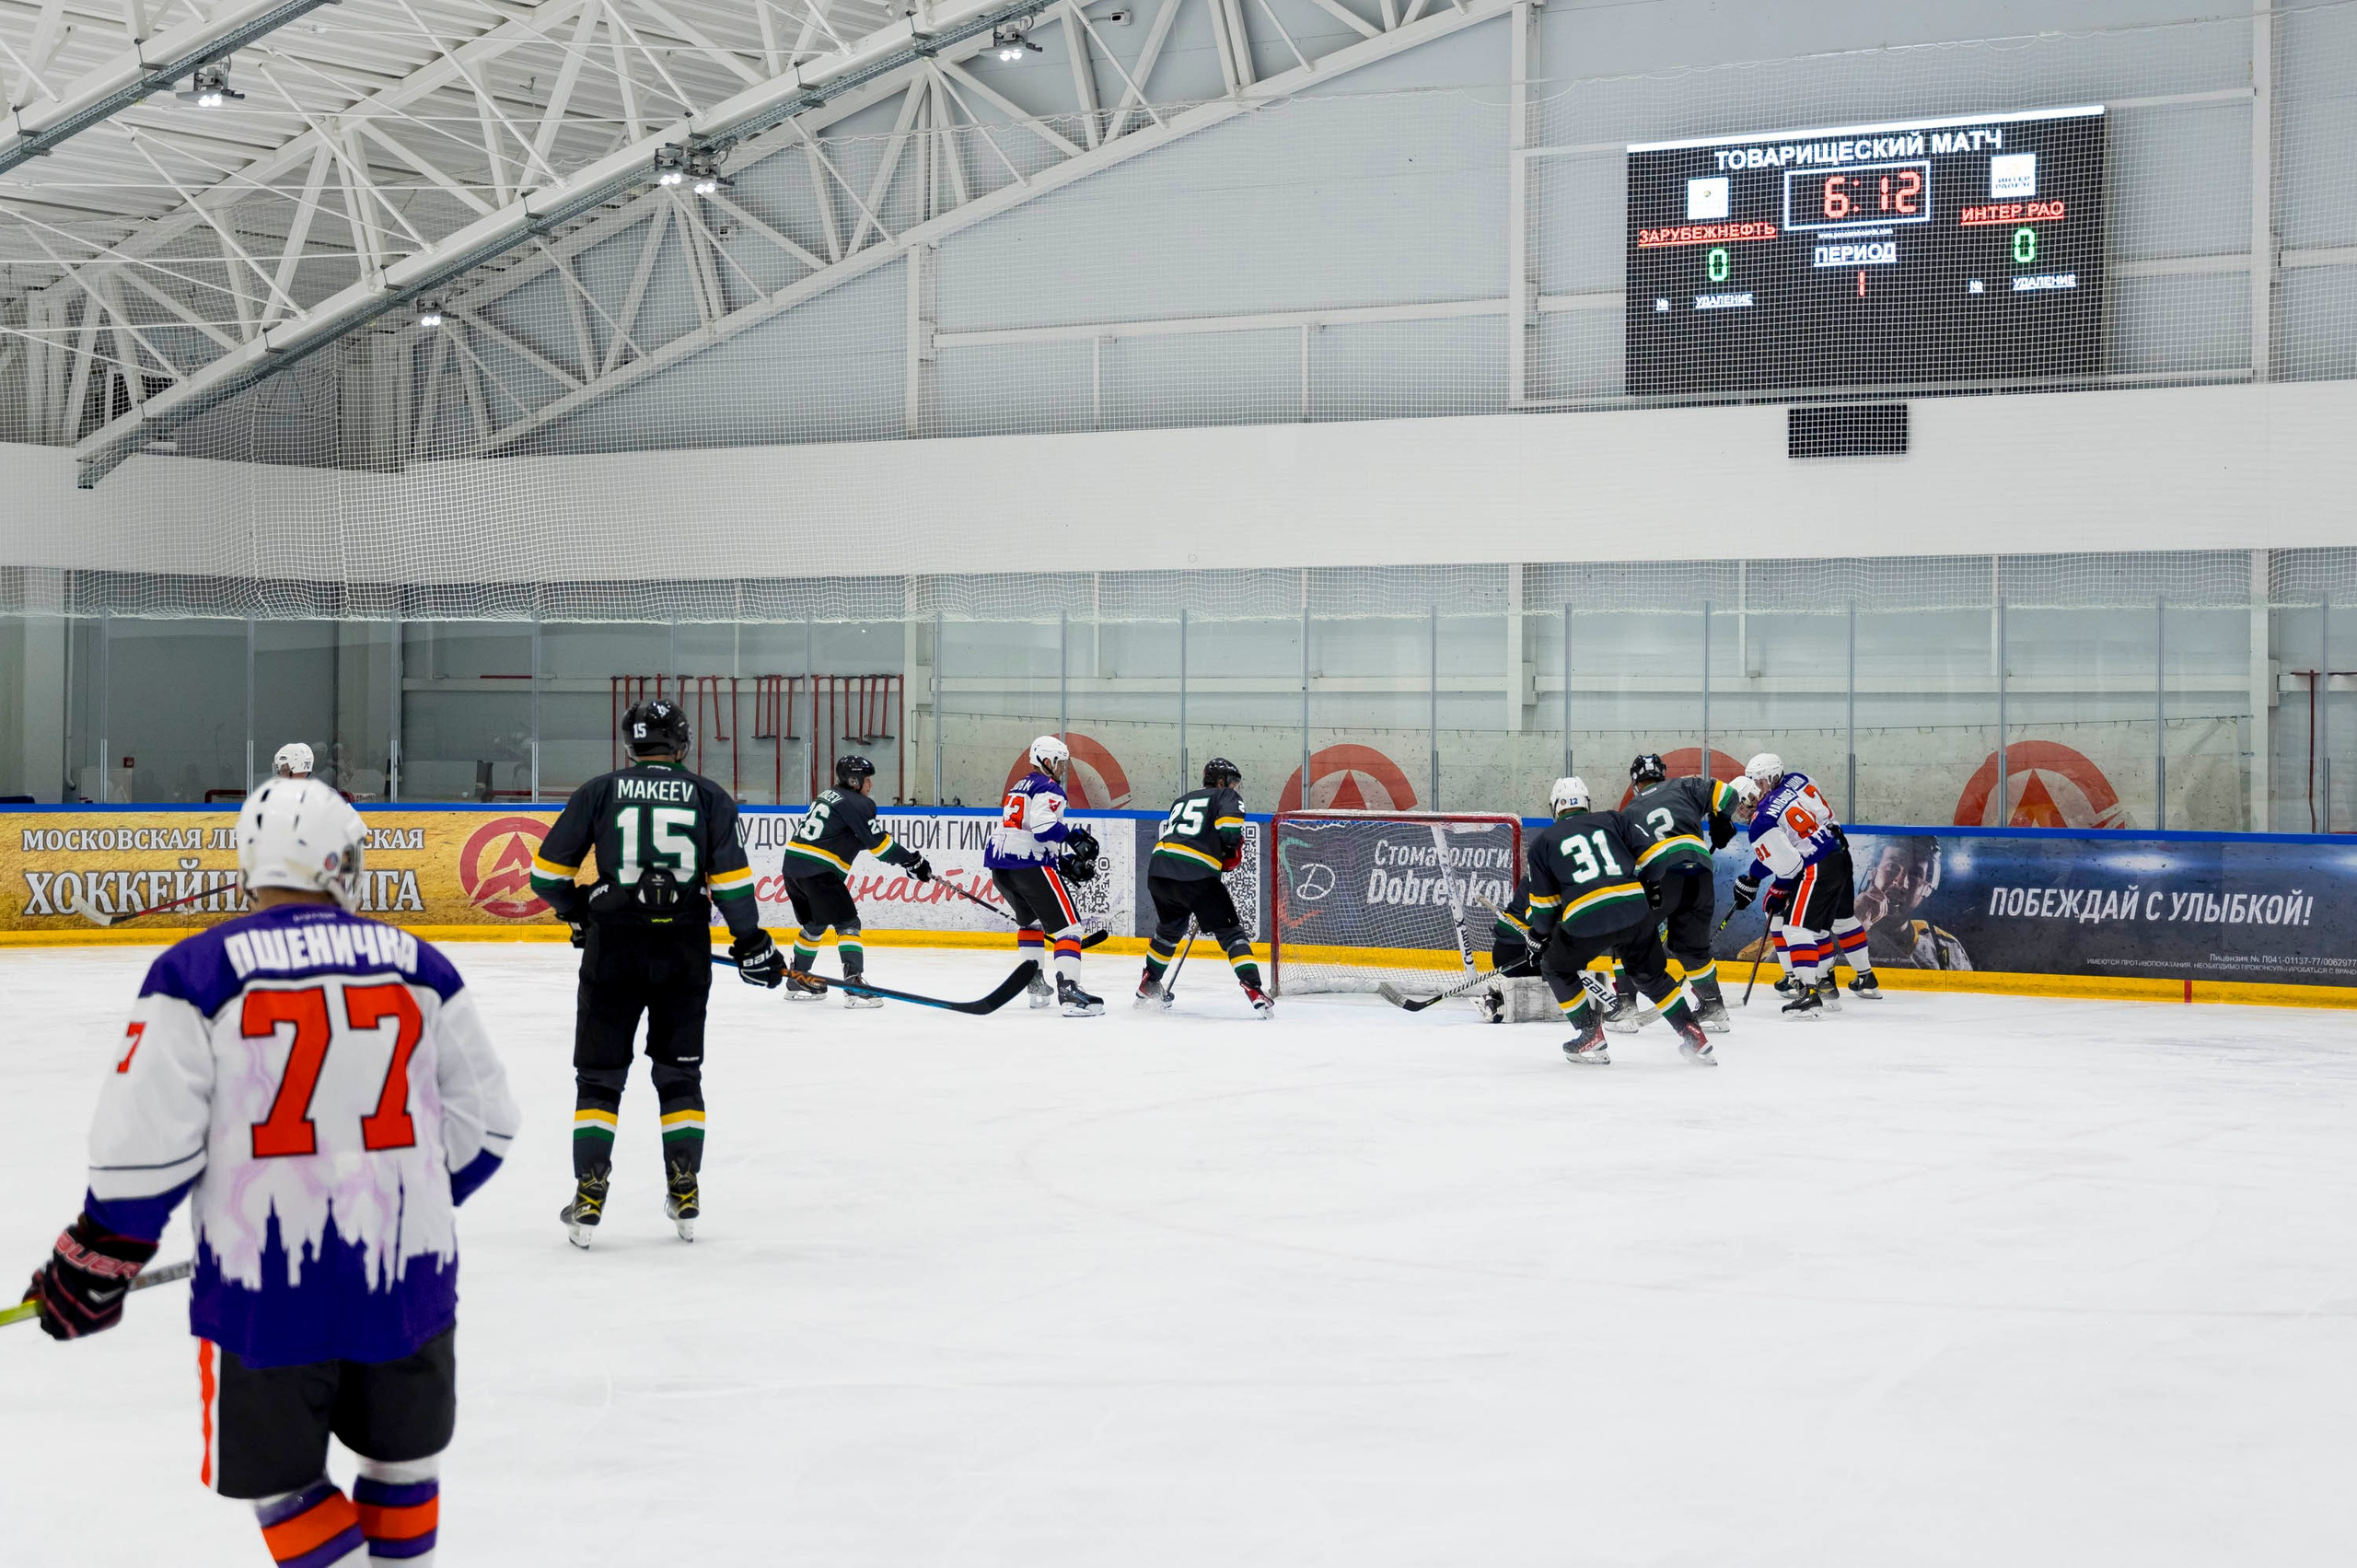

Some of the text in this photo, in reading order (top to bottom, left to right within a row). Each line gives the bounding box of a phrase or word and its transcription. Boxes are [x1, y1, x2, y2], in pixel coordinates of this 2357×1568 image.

[1714, 130, 2003, 170] ТОВАРИЩЕСКИЙ МАТЧ
[1824, 171, 1921, 217] 6:12
[1961, 201, 2064, 223] ИНТЕР РАО
[1639, 222, 1776, 245] ЗАРУБЕЖНЕФТЬ
[2014, 228, 2036, 263] 0
[1709, 248, 1728, 281] 0
[1814, 242, 1897, 264] ПЕРИОД
[2013, 274, 2076, 289] УДАЛЕНИЕ
[1695, 294, 1753, 308] УДАЛЕНИЕ
[633, 722, 647, 738] 15
[618, 779, 694, 802] MAKEEV
[23, 828, 203, 851] МОСКОВСКАЯ
[616, 806, 697, 885] 15
[1375, 840, 1513, 868] Стомаологи
[1561, 829, 1623, 884] 31
[1989, 885, 2314, 925] ПОБЕЖДАЙ С УЛЫБКОЙ!
[224, 923, 418, 981] ПШЕНИЧКА
[2210, 954, 2247, 963] Лицензия
[2194, 962, 2240, 970] НЕОБХОДИМО
[241, 982, 424, 1158] 77
